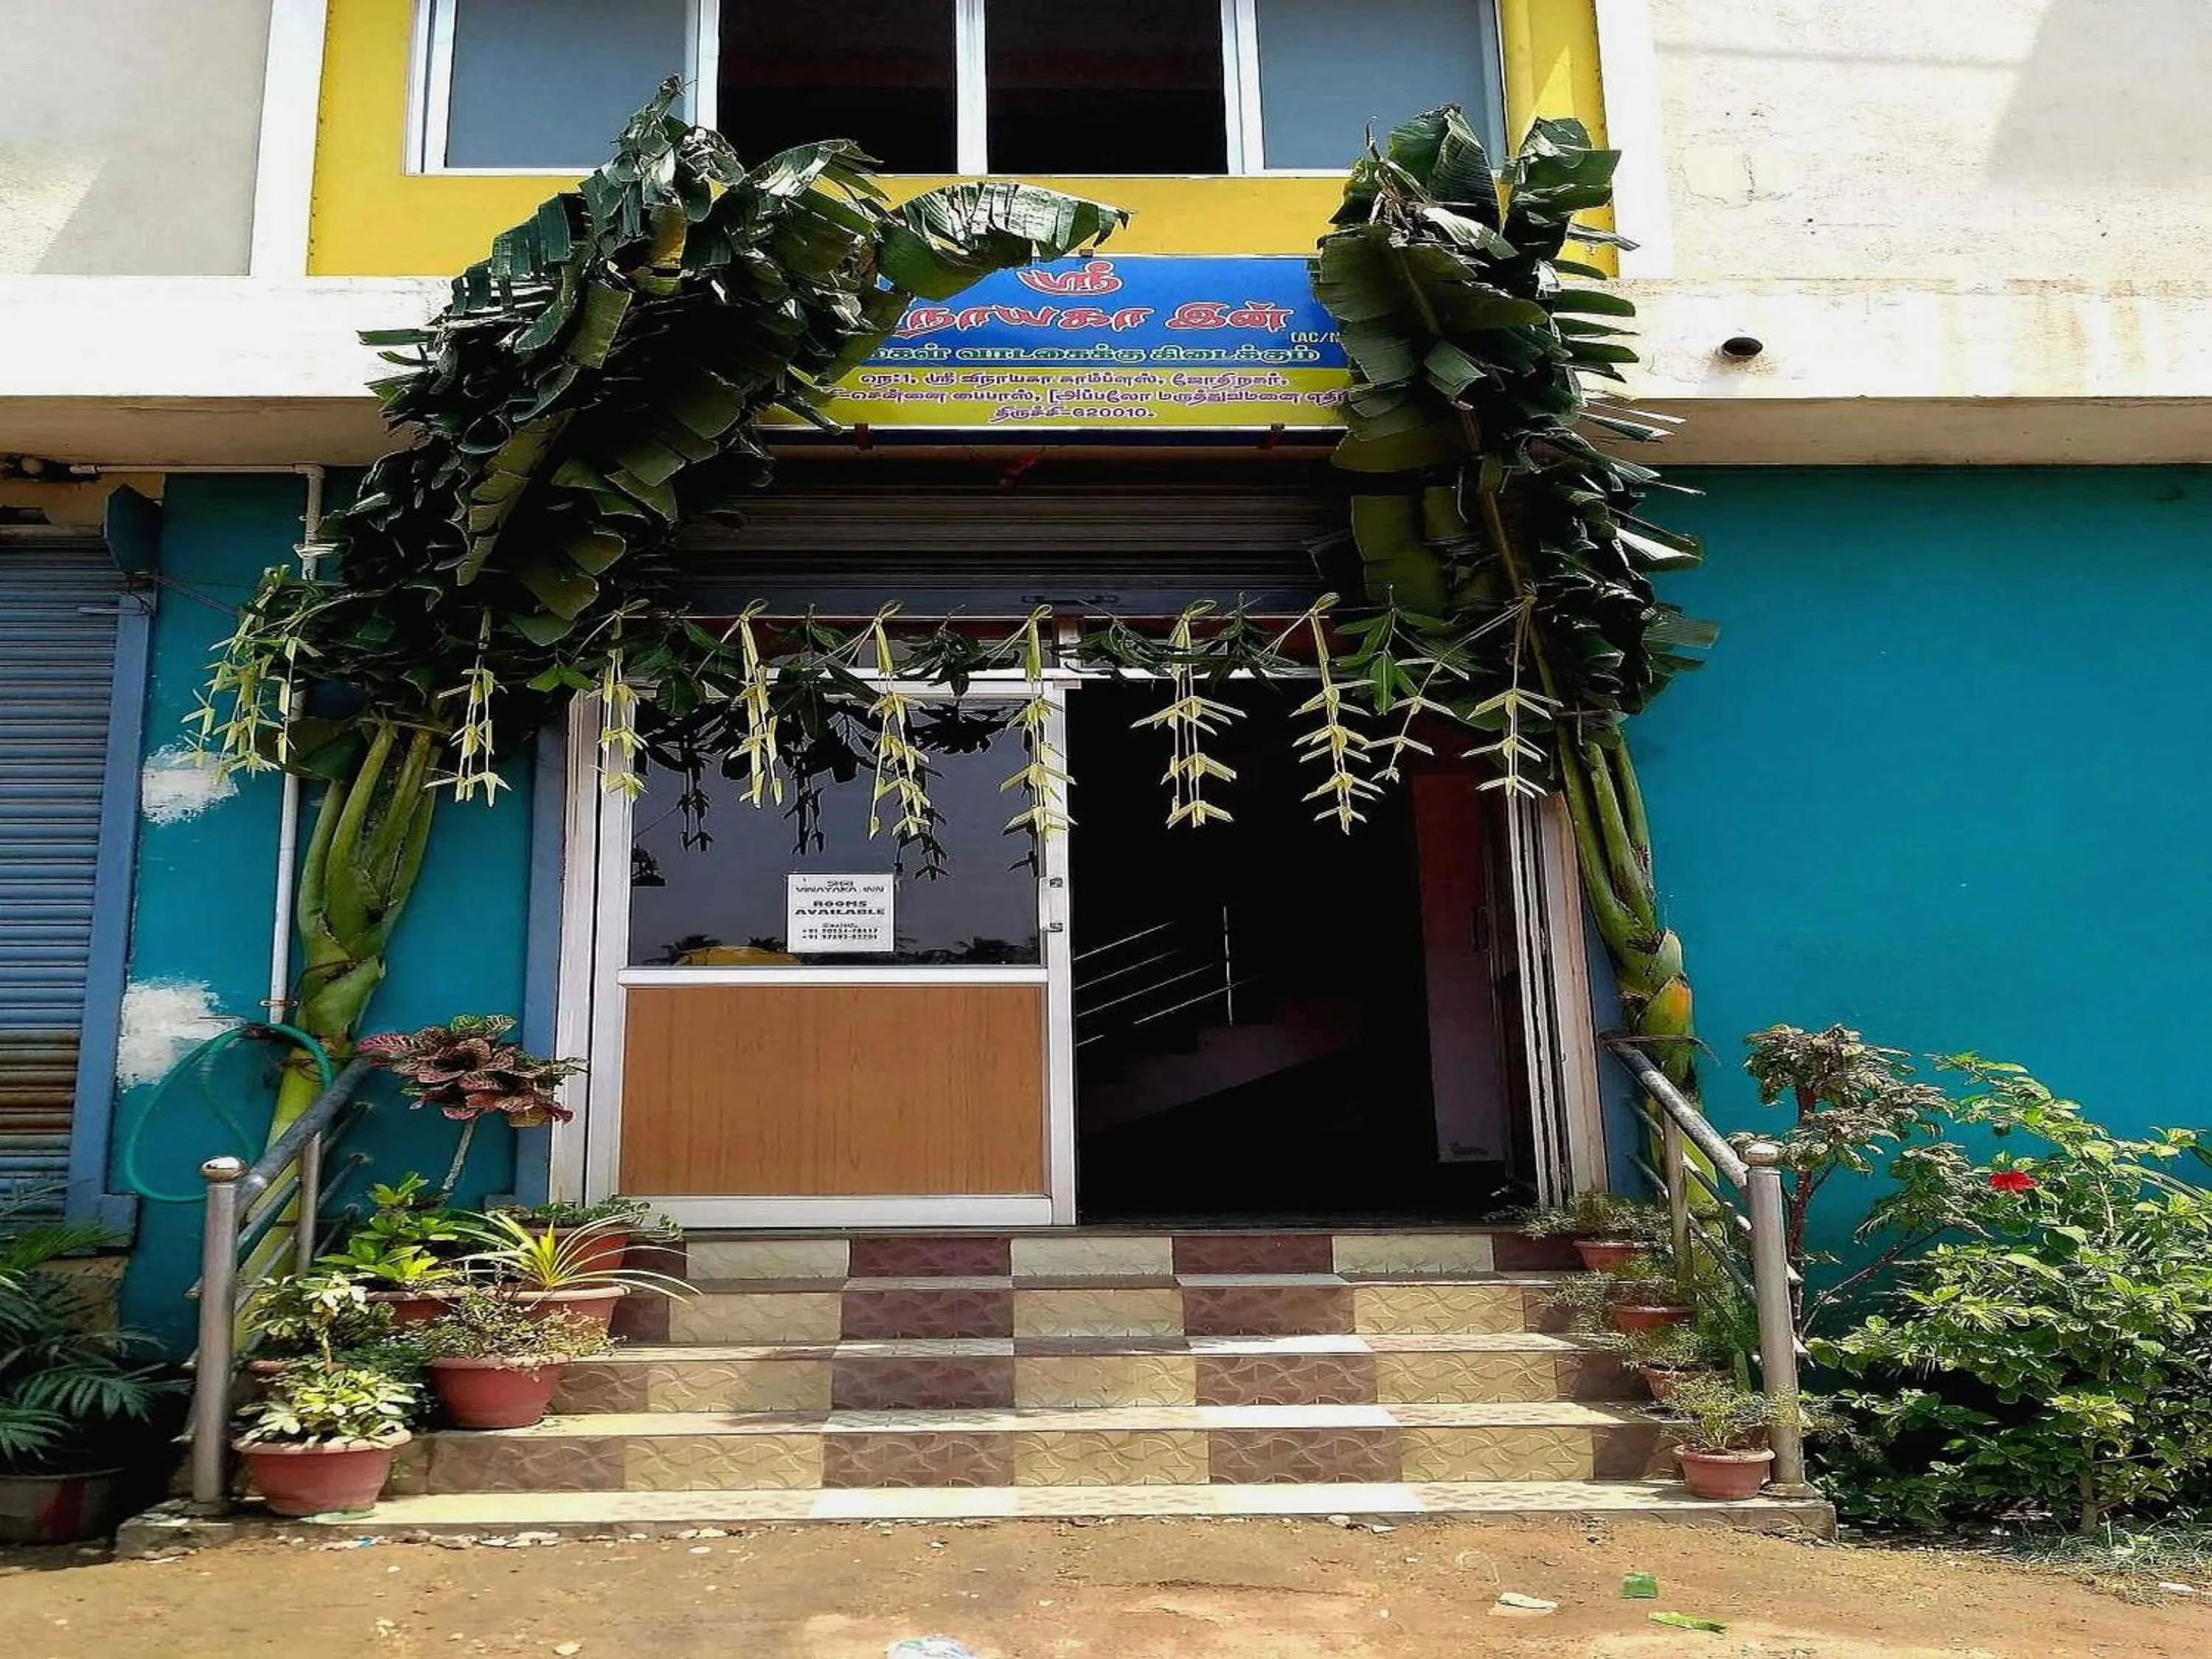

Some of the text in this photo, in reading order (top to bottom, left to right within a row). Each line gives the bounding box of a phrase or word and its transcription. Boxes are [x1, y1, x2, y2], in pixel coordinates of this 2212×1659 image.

[891, 301, 1294, 338] நாயகா இன்
[1150, 344, 1321, 364] கிடைக்கும்
